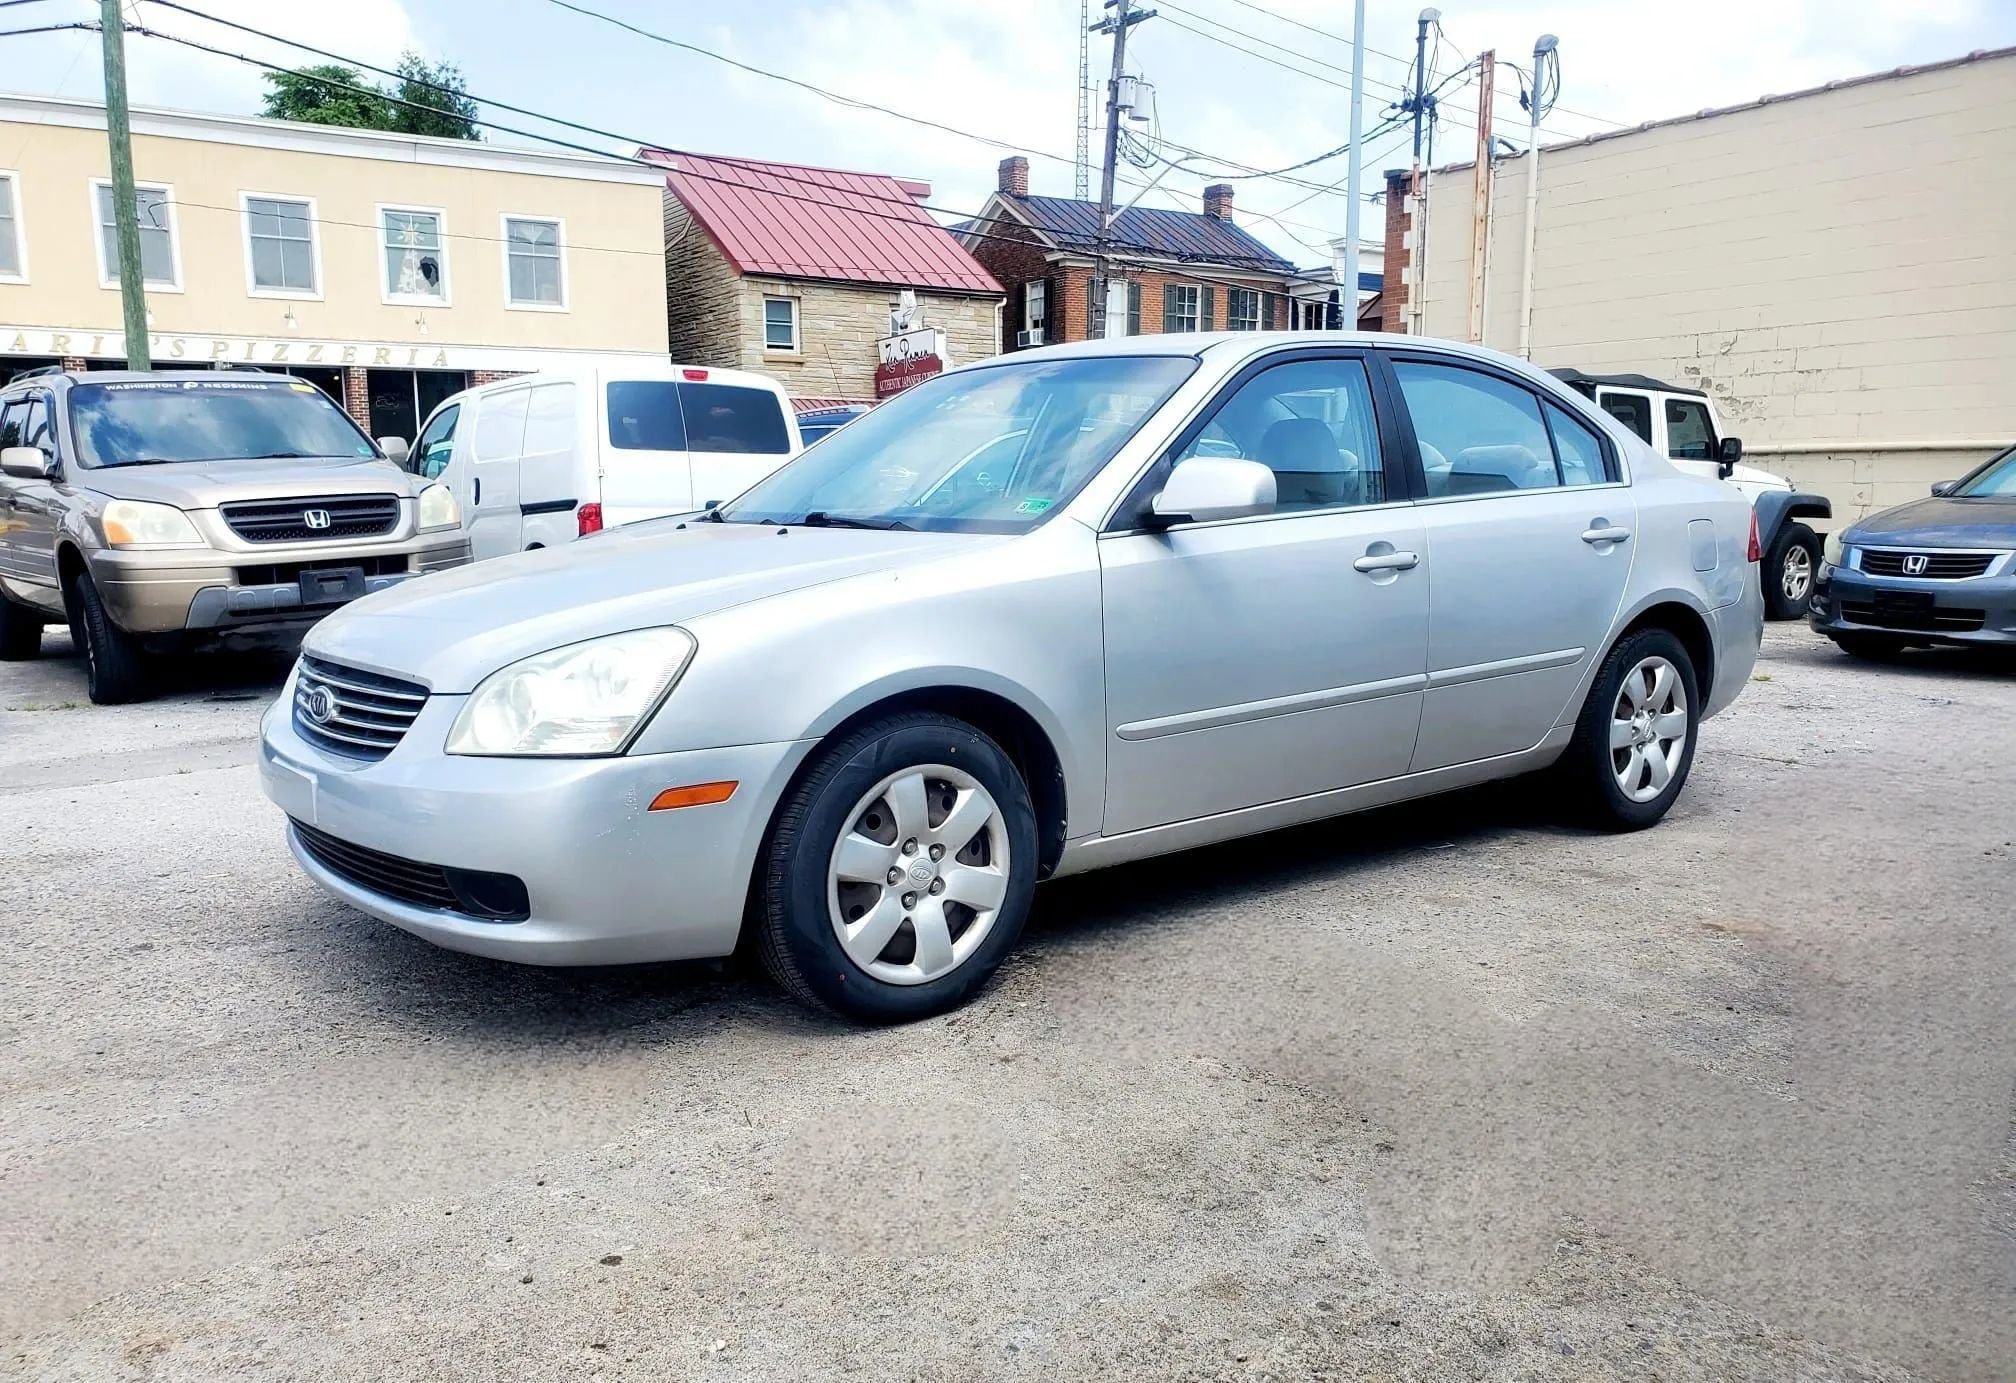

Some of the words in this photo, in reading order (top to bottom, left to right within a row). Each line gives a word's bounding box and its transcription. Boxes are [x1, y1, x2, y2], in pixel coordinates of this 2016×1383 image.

[8, 333, 186, 358] ARI'S
[208, 341, 449, 367] PIZZERIA
[900, 338, 930, 373] Ramen
[105, 383, 178, 391] WASHINGTON
[311, 694, 326, 715] KIA
